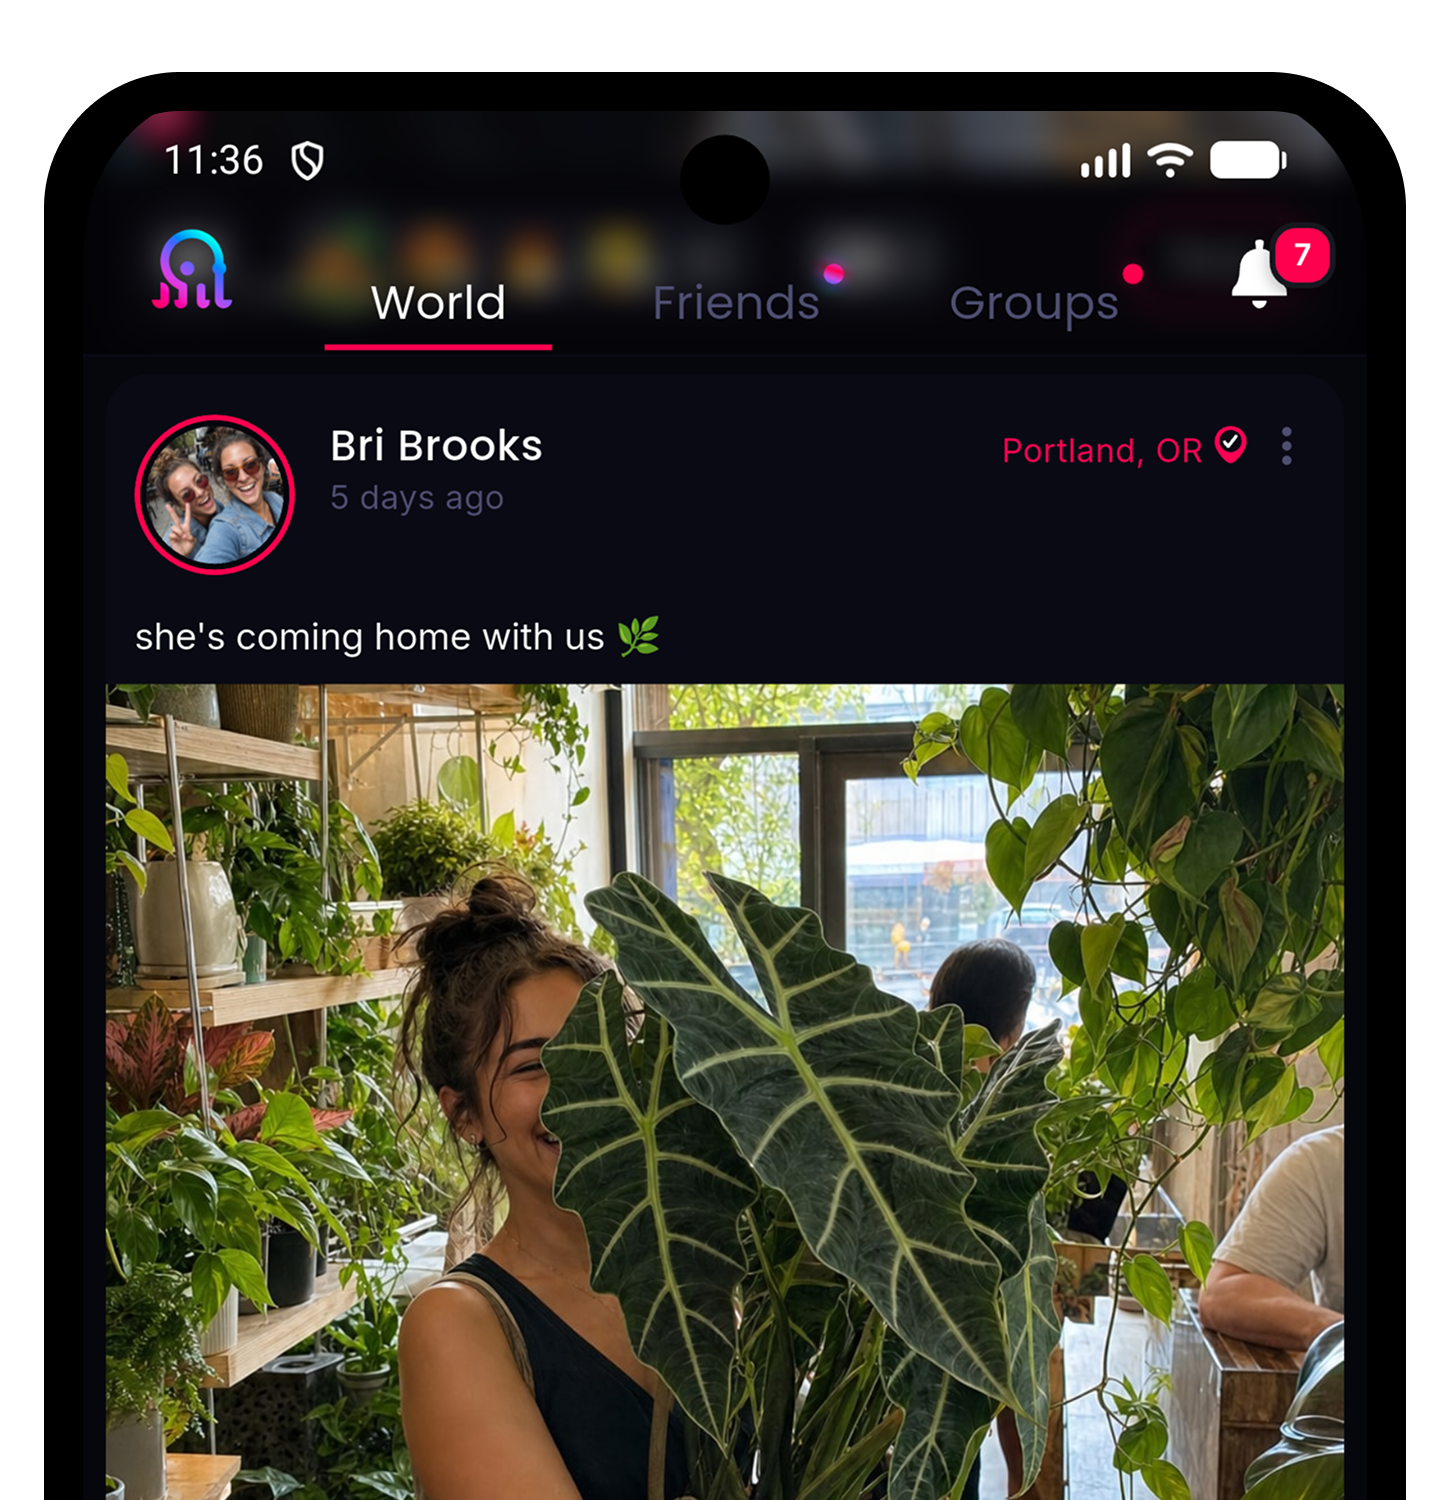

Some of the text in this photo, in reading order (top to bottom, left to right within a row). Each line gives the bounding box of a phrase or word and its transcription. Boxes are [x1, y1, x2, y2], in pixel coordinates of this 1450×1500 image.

[166, 144, 263, 174] 11:36
[1295, 243, 1310, 265] 7
[371, 285, 503, 319] World
[654, 285, 819, 319] Friends
[951, 286, 1117, 331] Groups
[333, 427, 541, 461] Bri Brooks
[1004, 438, 1202, 468] Portland, OR
[332, 485, 503, 516] 5 days ago
[136, 622, 604, 657] she's coming home with us
